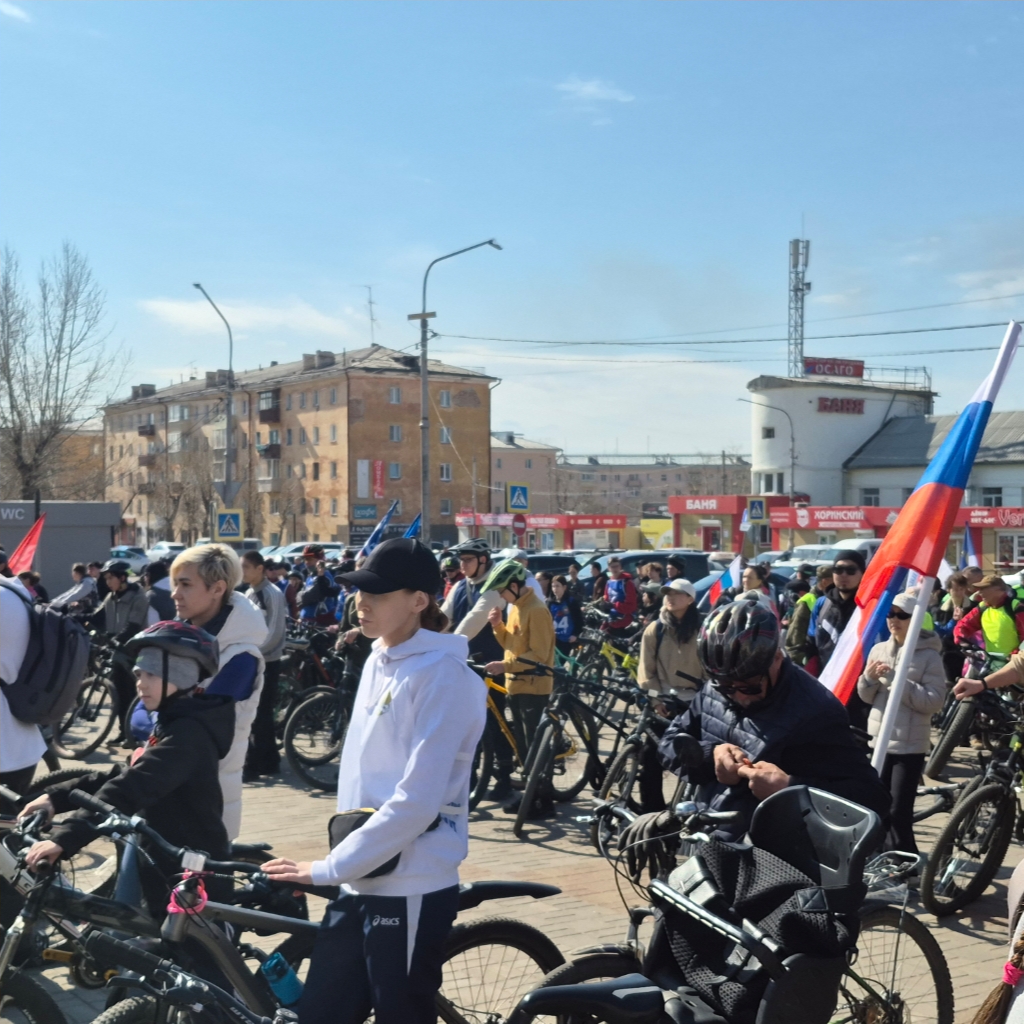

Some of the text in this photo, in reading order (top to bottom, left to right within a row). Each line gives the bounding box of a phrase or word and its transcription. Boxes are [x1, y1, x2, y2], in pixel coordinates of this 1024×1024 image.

[815, 364, 853, 375] ОСАГО
[817, 397, 865, 414] БАНЯ
[686, 499, 717, 510] БАНЯ
[1, 508, 25, 520] WC
[814, 509, 864, 520] ХОРИНСКИЙ
